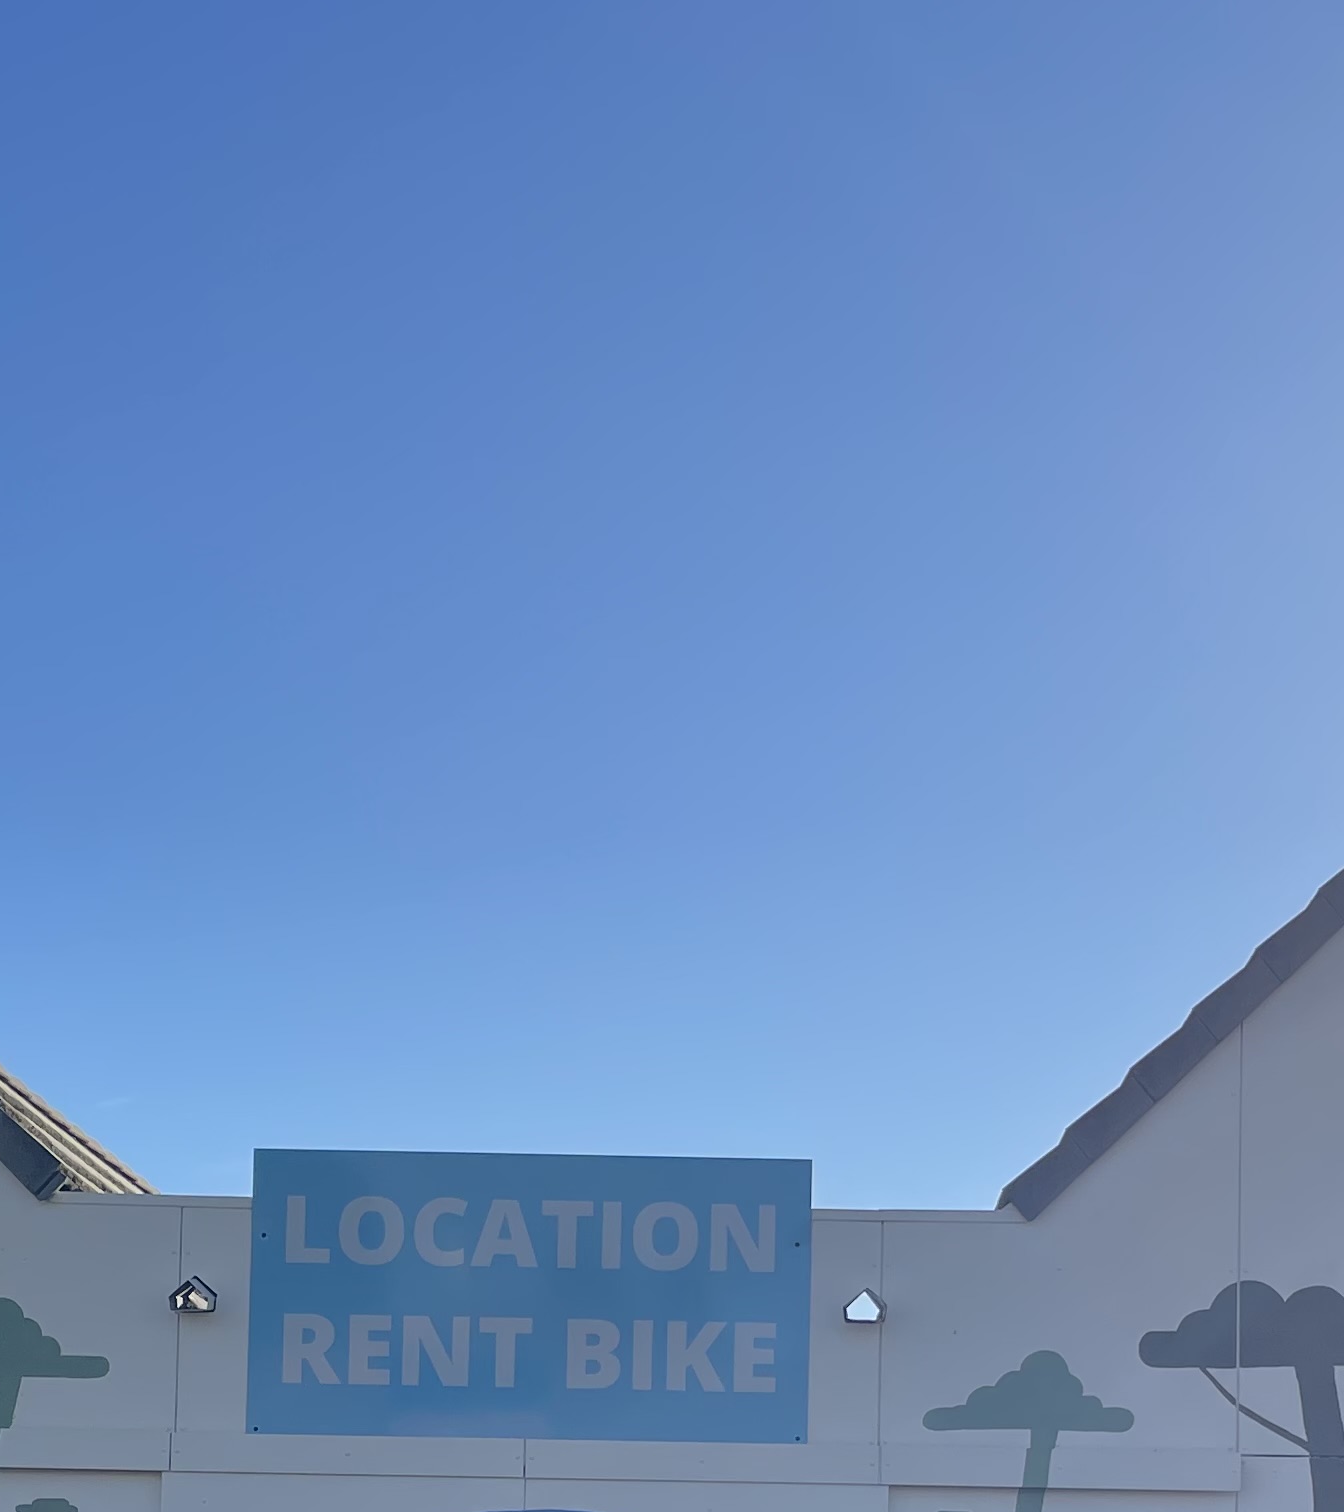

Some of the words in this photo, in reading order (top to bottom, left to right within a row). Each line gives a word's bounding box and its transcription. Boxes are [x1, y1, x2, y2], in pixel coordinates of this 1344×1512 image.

[285, 1195, 776, 1273] LOCATION
[281, 1313, 533, 1388] RENT
[565, 1318, 777, 1393] BIKE
